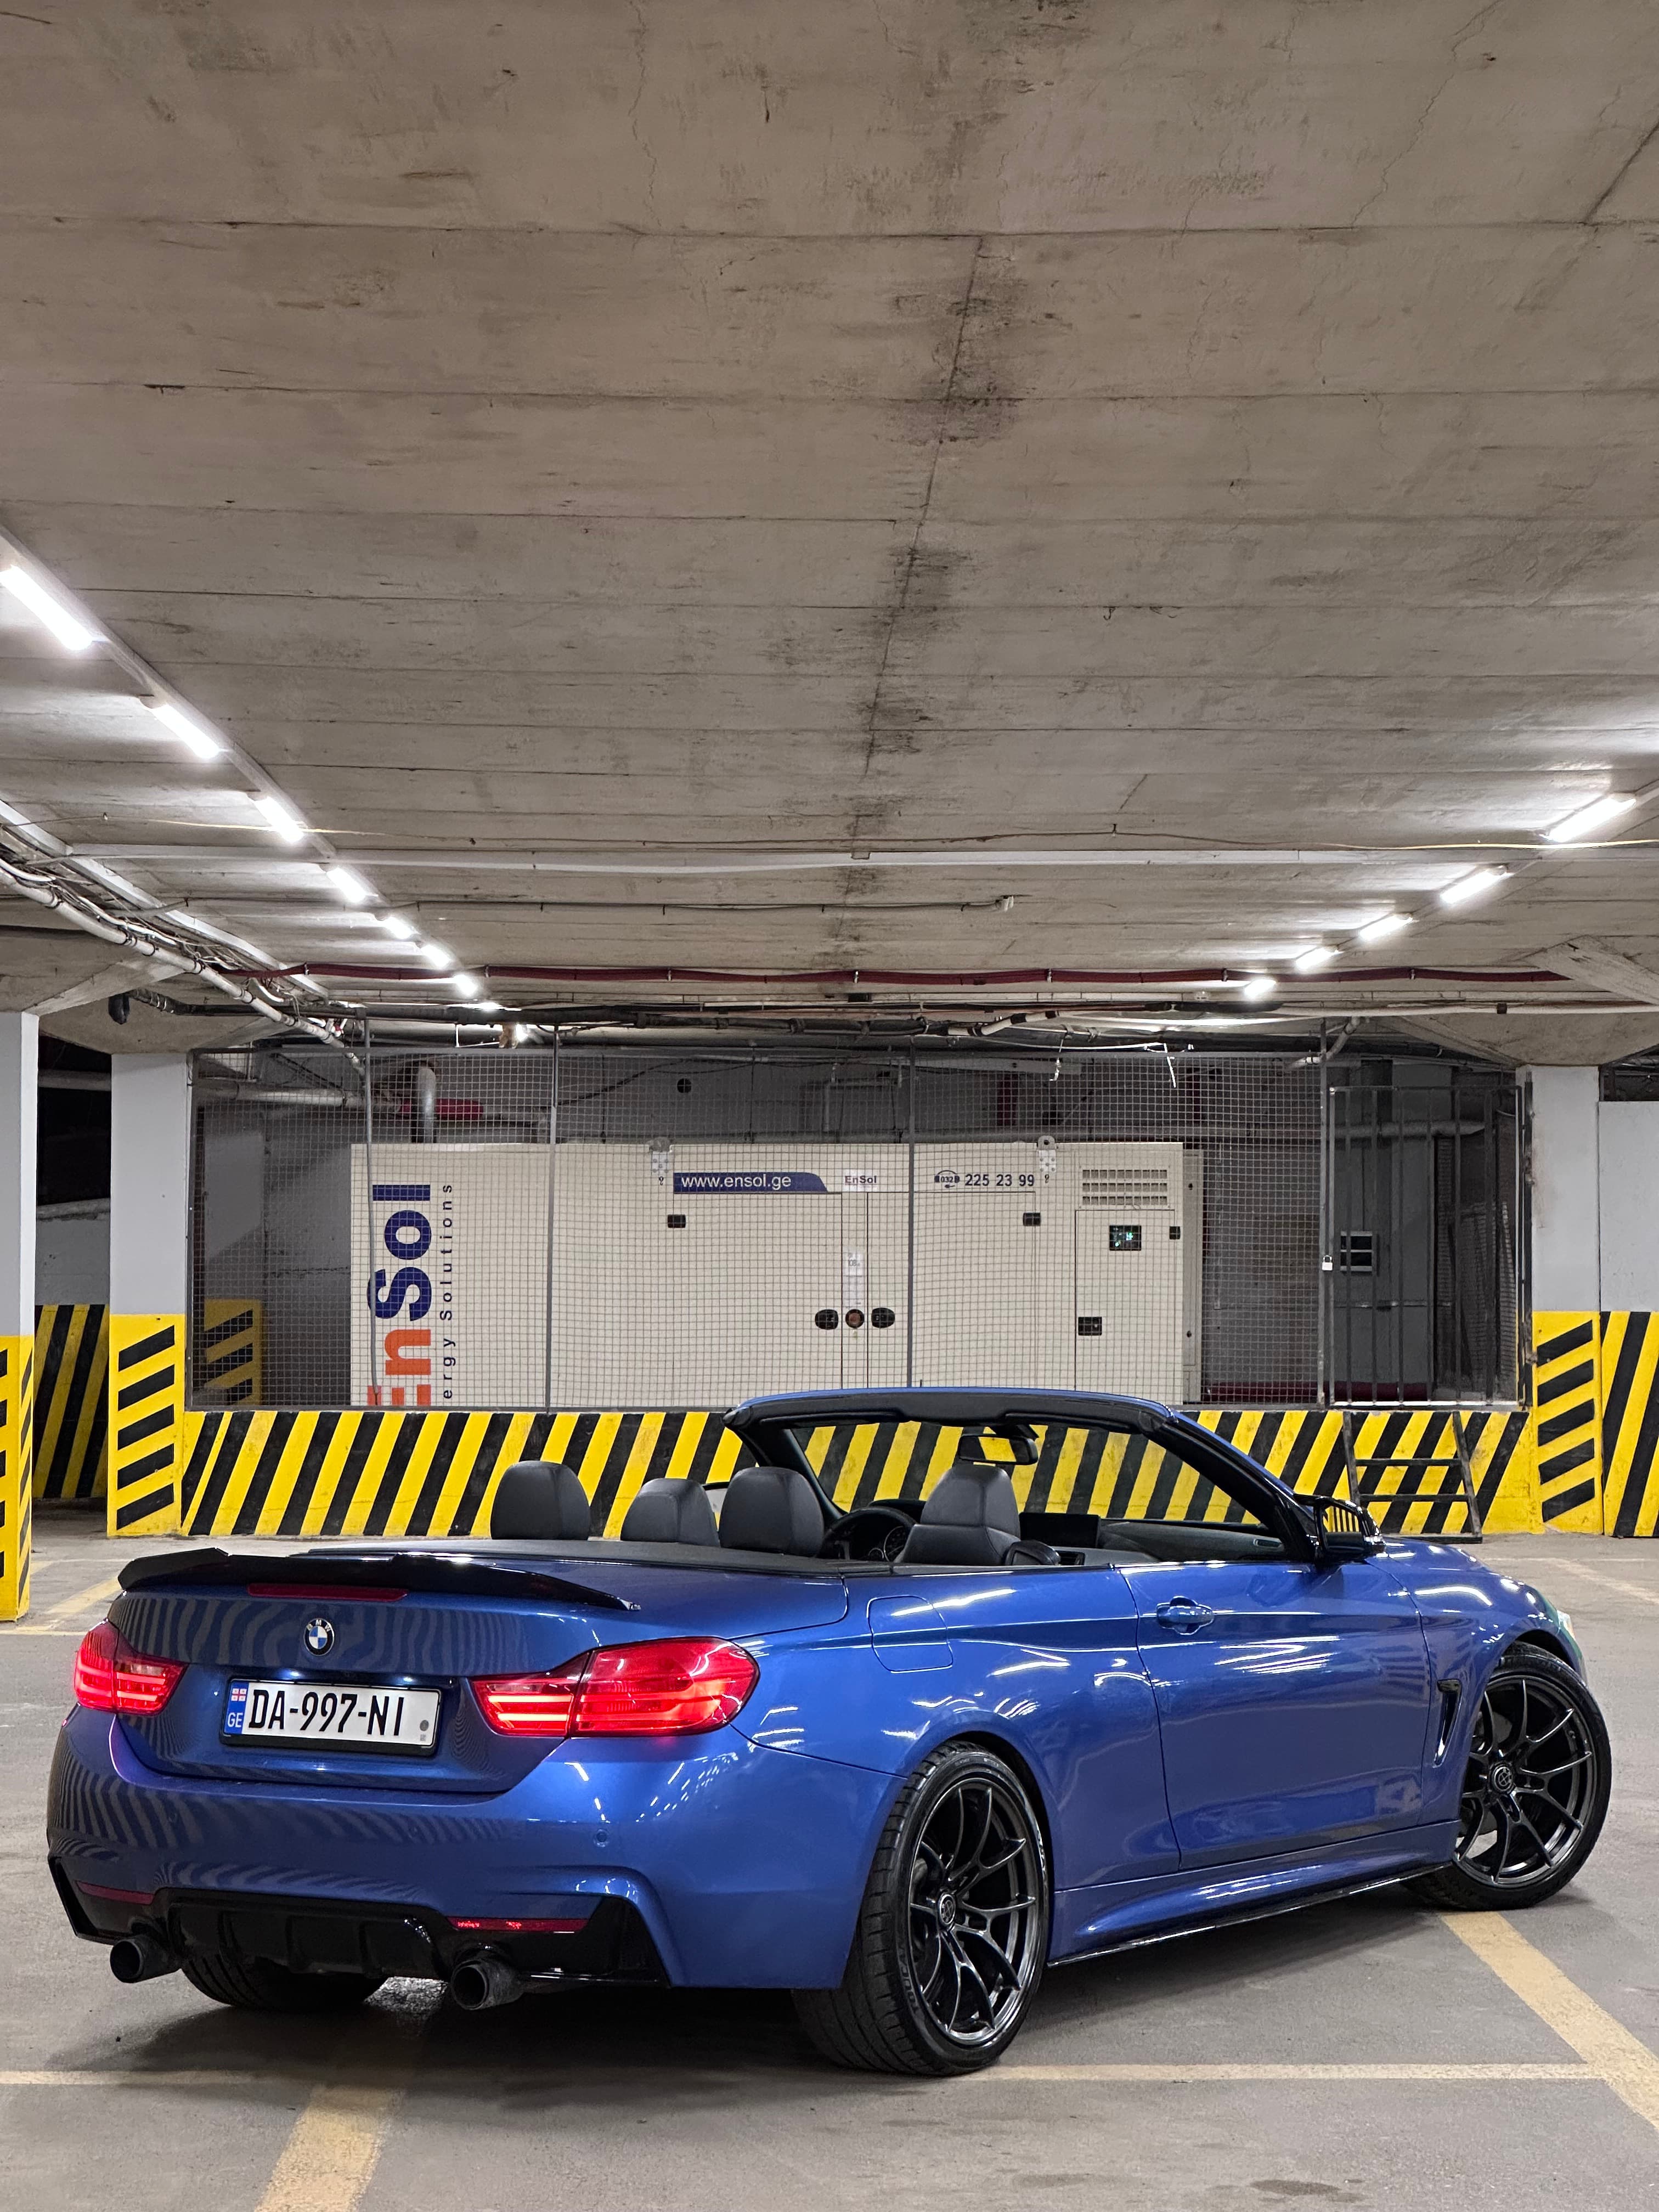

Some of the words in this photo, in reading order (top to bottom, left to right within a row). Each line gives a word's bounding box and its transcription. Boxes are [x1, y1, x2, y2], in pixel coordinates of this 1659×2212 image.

[681, 1173, 791, 1190] www.ensol.ge
[845, 1175, 877, 1183] EnSol
[965, 1174, 990, 1186] 225
[996, 1174, 1012, 1186] 23
[1019, 1174, 1035, 1186] 99
[439, 1185, 453, 1321] Solutions
[228, 1712, 242, 1728] GE
[249, 1689, 404, 1736] DA-997-NI
